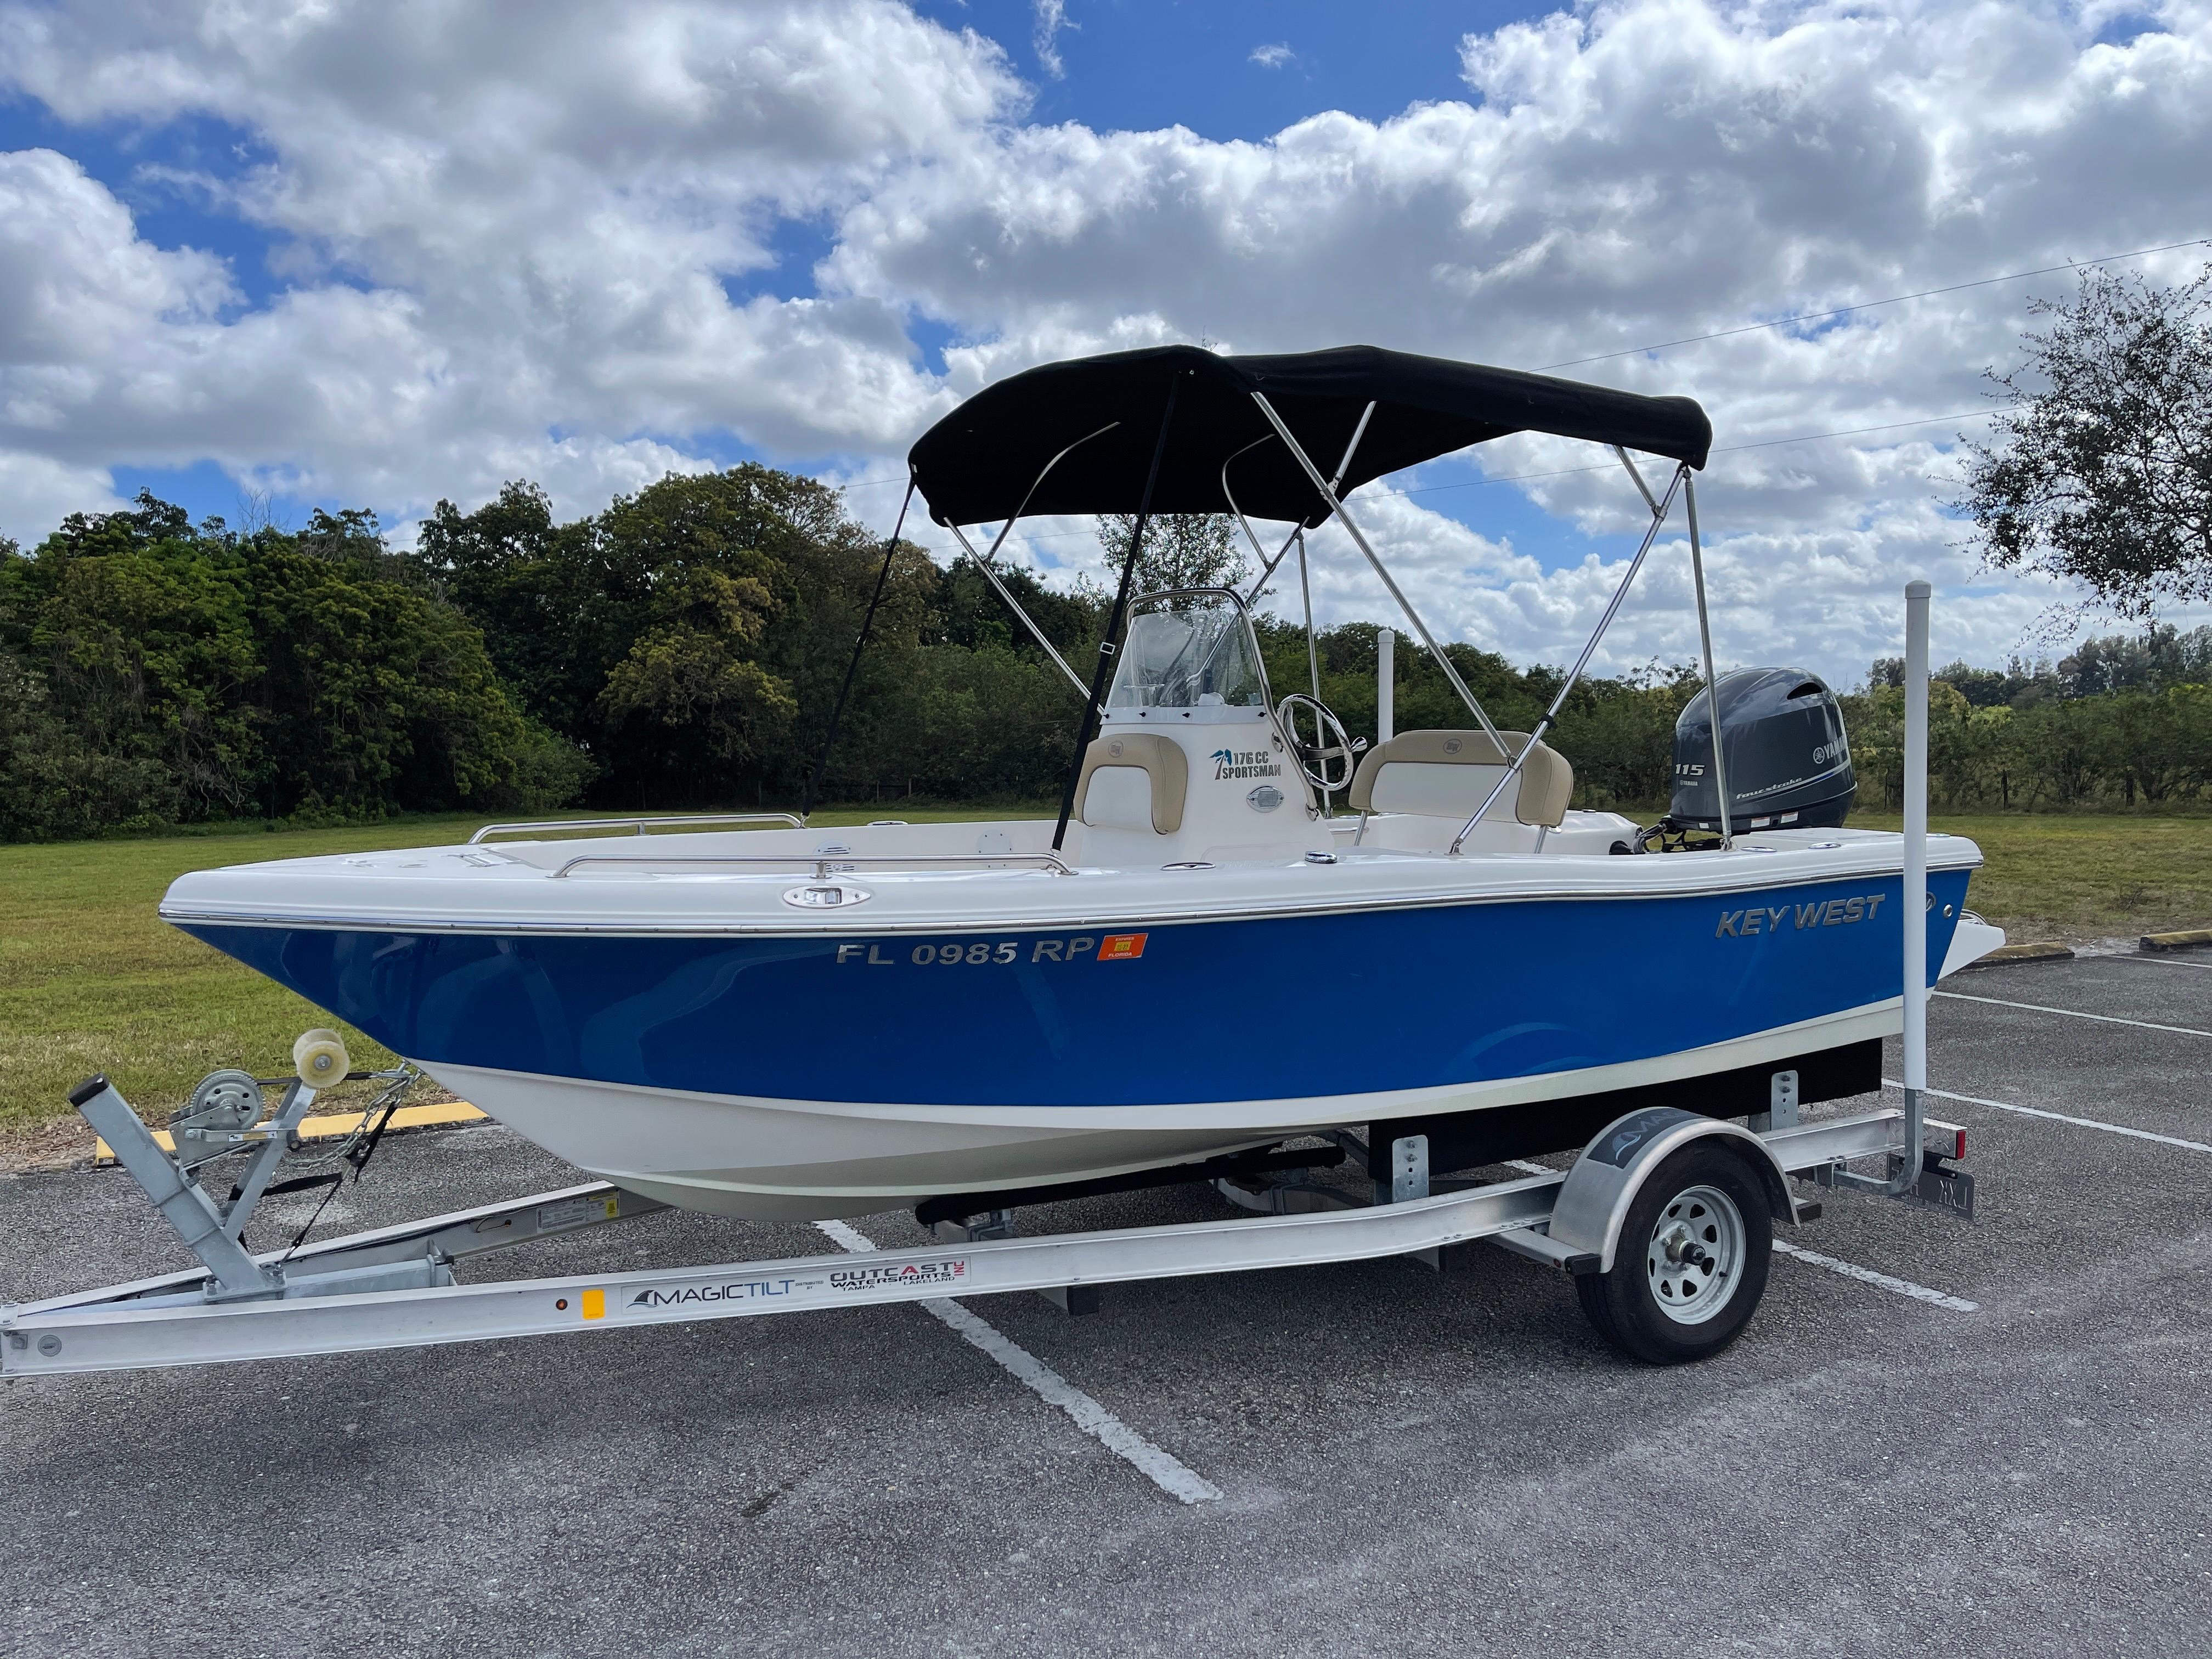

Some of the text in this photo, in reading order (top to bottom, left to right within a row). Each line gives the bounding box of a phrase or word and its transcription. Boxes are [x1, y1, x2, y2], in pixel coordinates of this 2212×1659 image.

[1824, 735, 1846, 759] YAMA
[1233, 751, 1269, 765] 176 CC
[1222, 764, 1281, 779] SPORTSMAN
[1675, 763, 1706, 776] 115
[1715, 893, 1886, 938] KEY WEST
[836, 937, 1095, 965] FL 0985 RP
[830, 1262, 953, 1282] OUTCAST
[953, 1261, 965, 1276] INC
[831, 1271, 951, 1288] WATERSPORTS
[904, 1276, 955, 1285] LAKELAND
[653, 1279, 795, 1305] MAGICTILT
